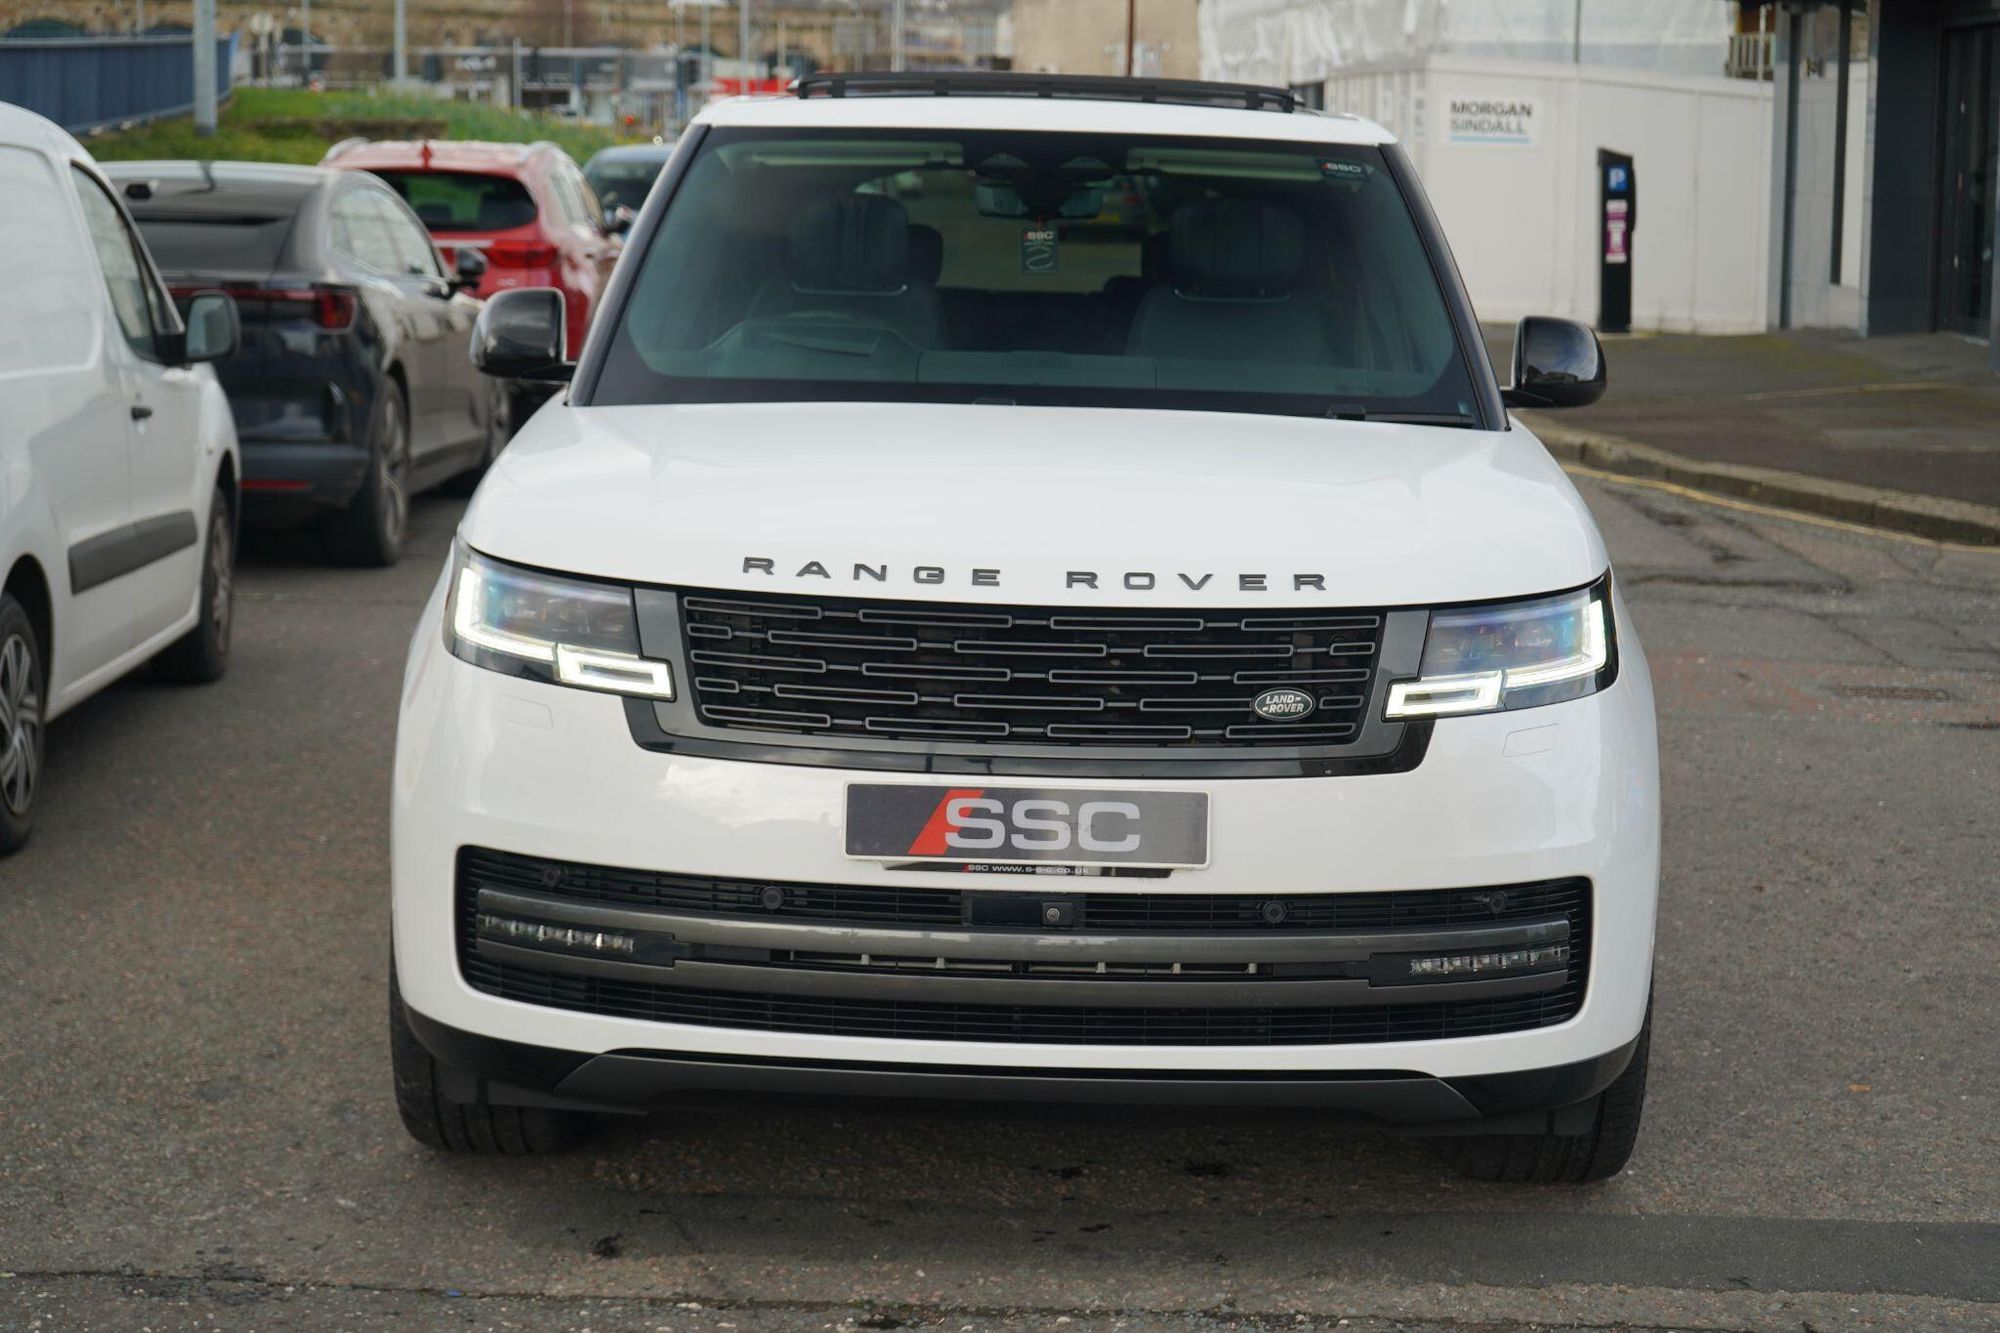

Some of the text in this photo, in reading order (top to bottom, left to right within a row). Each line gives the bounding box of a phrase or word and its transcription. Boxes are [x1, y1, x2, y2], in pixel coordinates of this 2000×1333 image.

[1450, 101, 1532, 116] MORGAN
[1450, 119, 1527, 134] SINDALL
[1609, 167, 1626, 189] P
[742, 556, 1327, 592] RANGE ROVER
[1265, 693, 1295, 704] LAND
[1268, 703, 1304, 713] ROVER
[944, 797, 1140, 852] SSC
